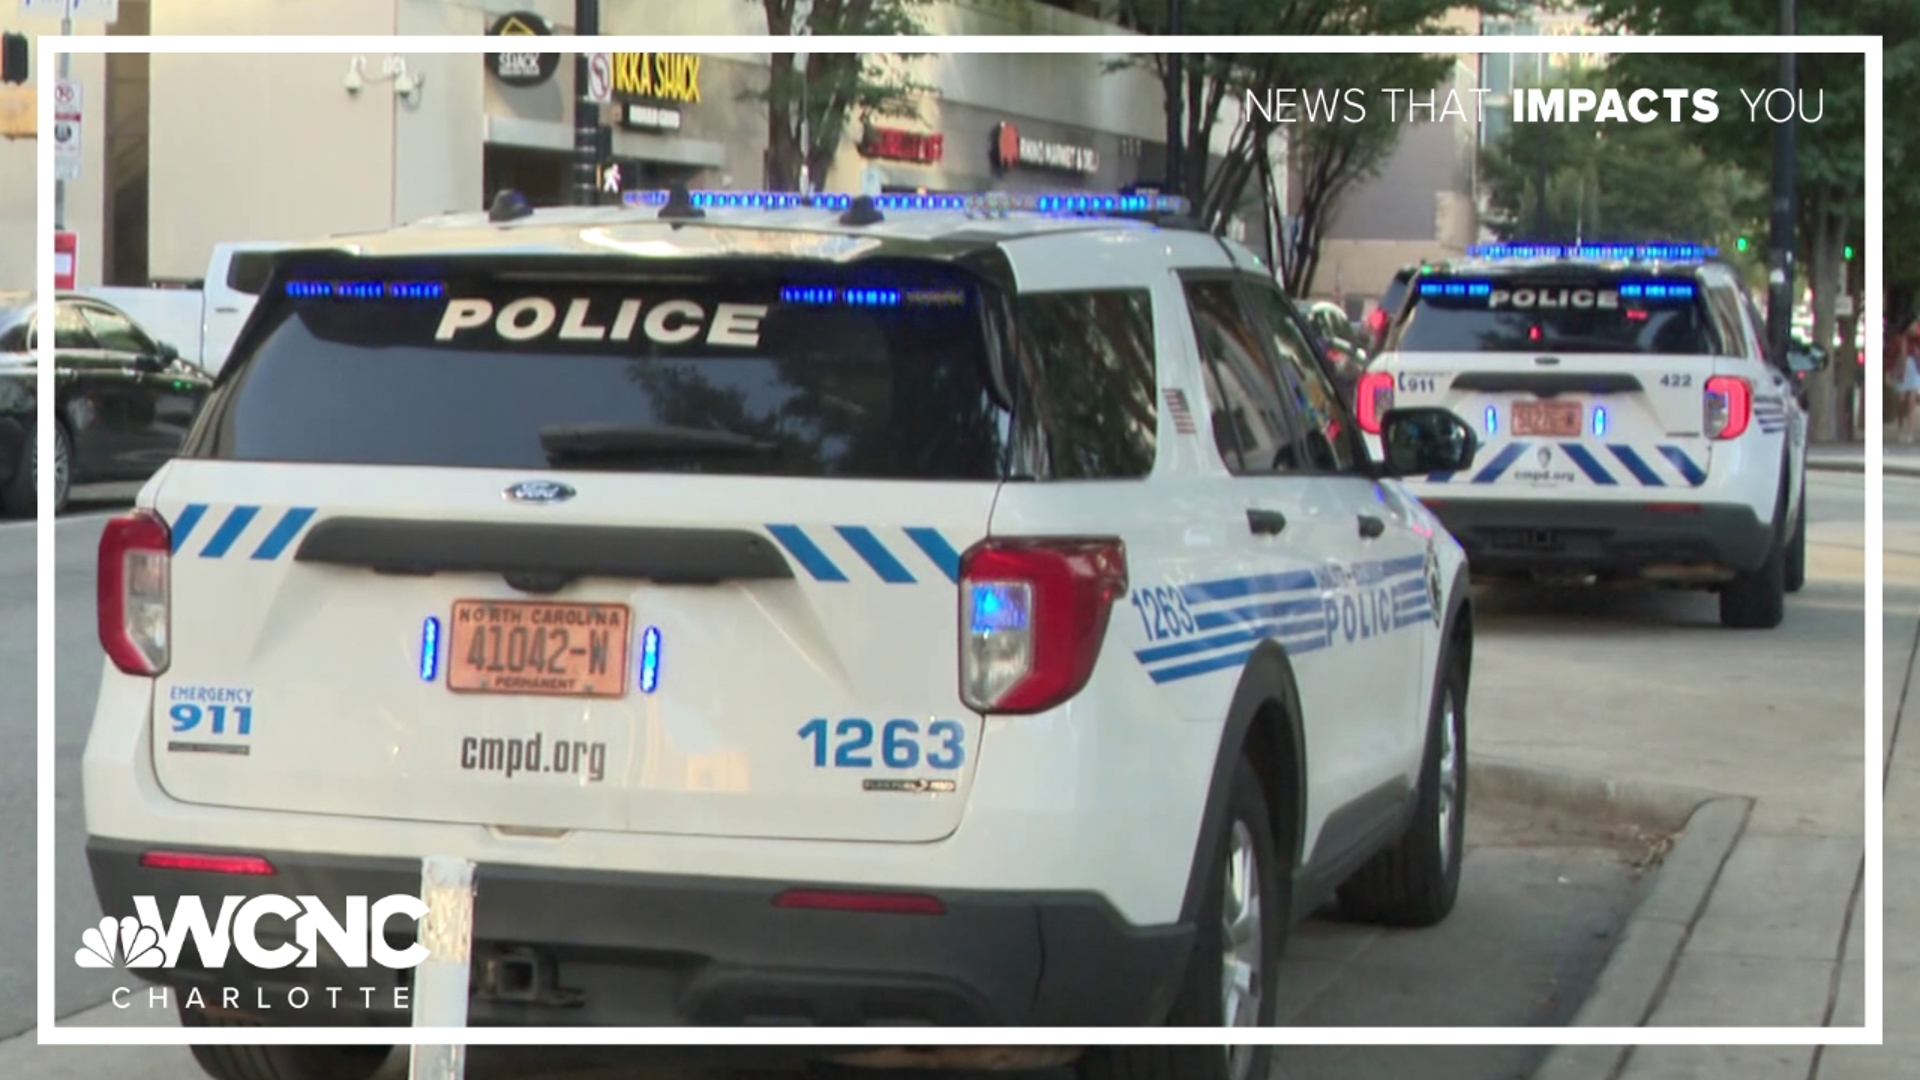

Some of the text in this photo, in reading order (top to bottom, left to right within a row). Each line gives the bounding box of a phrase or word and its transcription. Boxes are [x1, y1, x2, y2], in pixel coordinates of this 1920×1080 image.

[1488, 288, 1619, 308] POLICE
[435, 297, 768, 348] POLICE
[1408, 378, 1435, 393] 911
[1660, 373, 1692, 387] 422
[459, 608, 621, 626] NORTH CAROLINA
[1131, 586, 1196, 641] 1263
[1325, 585, 1399, 647] POLICE
[170, 686, 254, 703] EMERGENCY
[495, 675, 577, 690] PERMANENT
[169, 703, 253, 736] 911
[797, 717, 966, 770] 1263
[461, 732, 606, 782] cmpd.org
